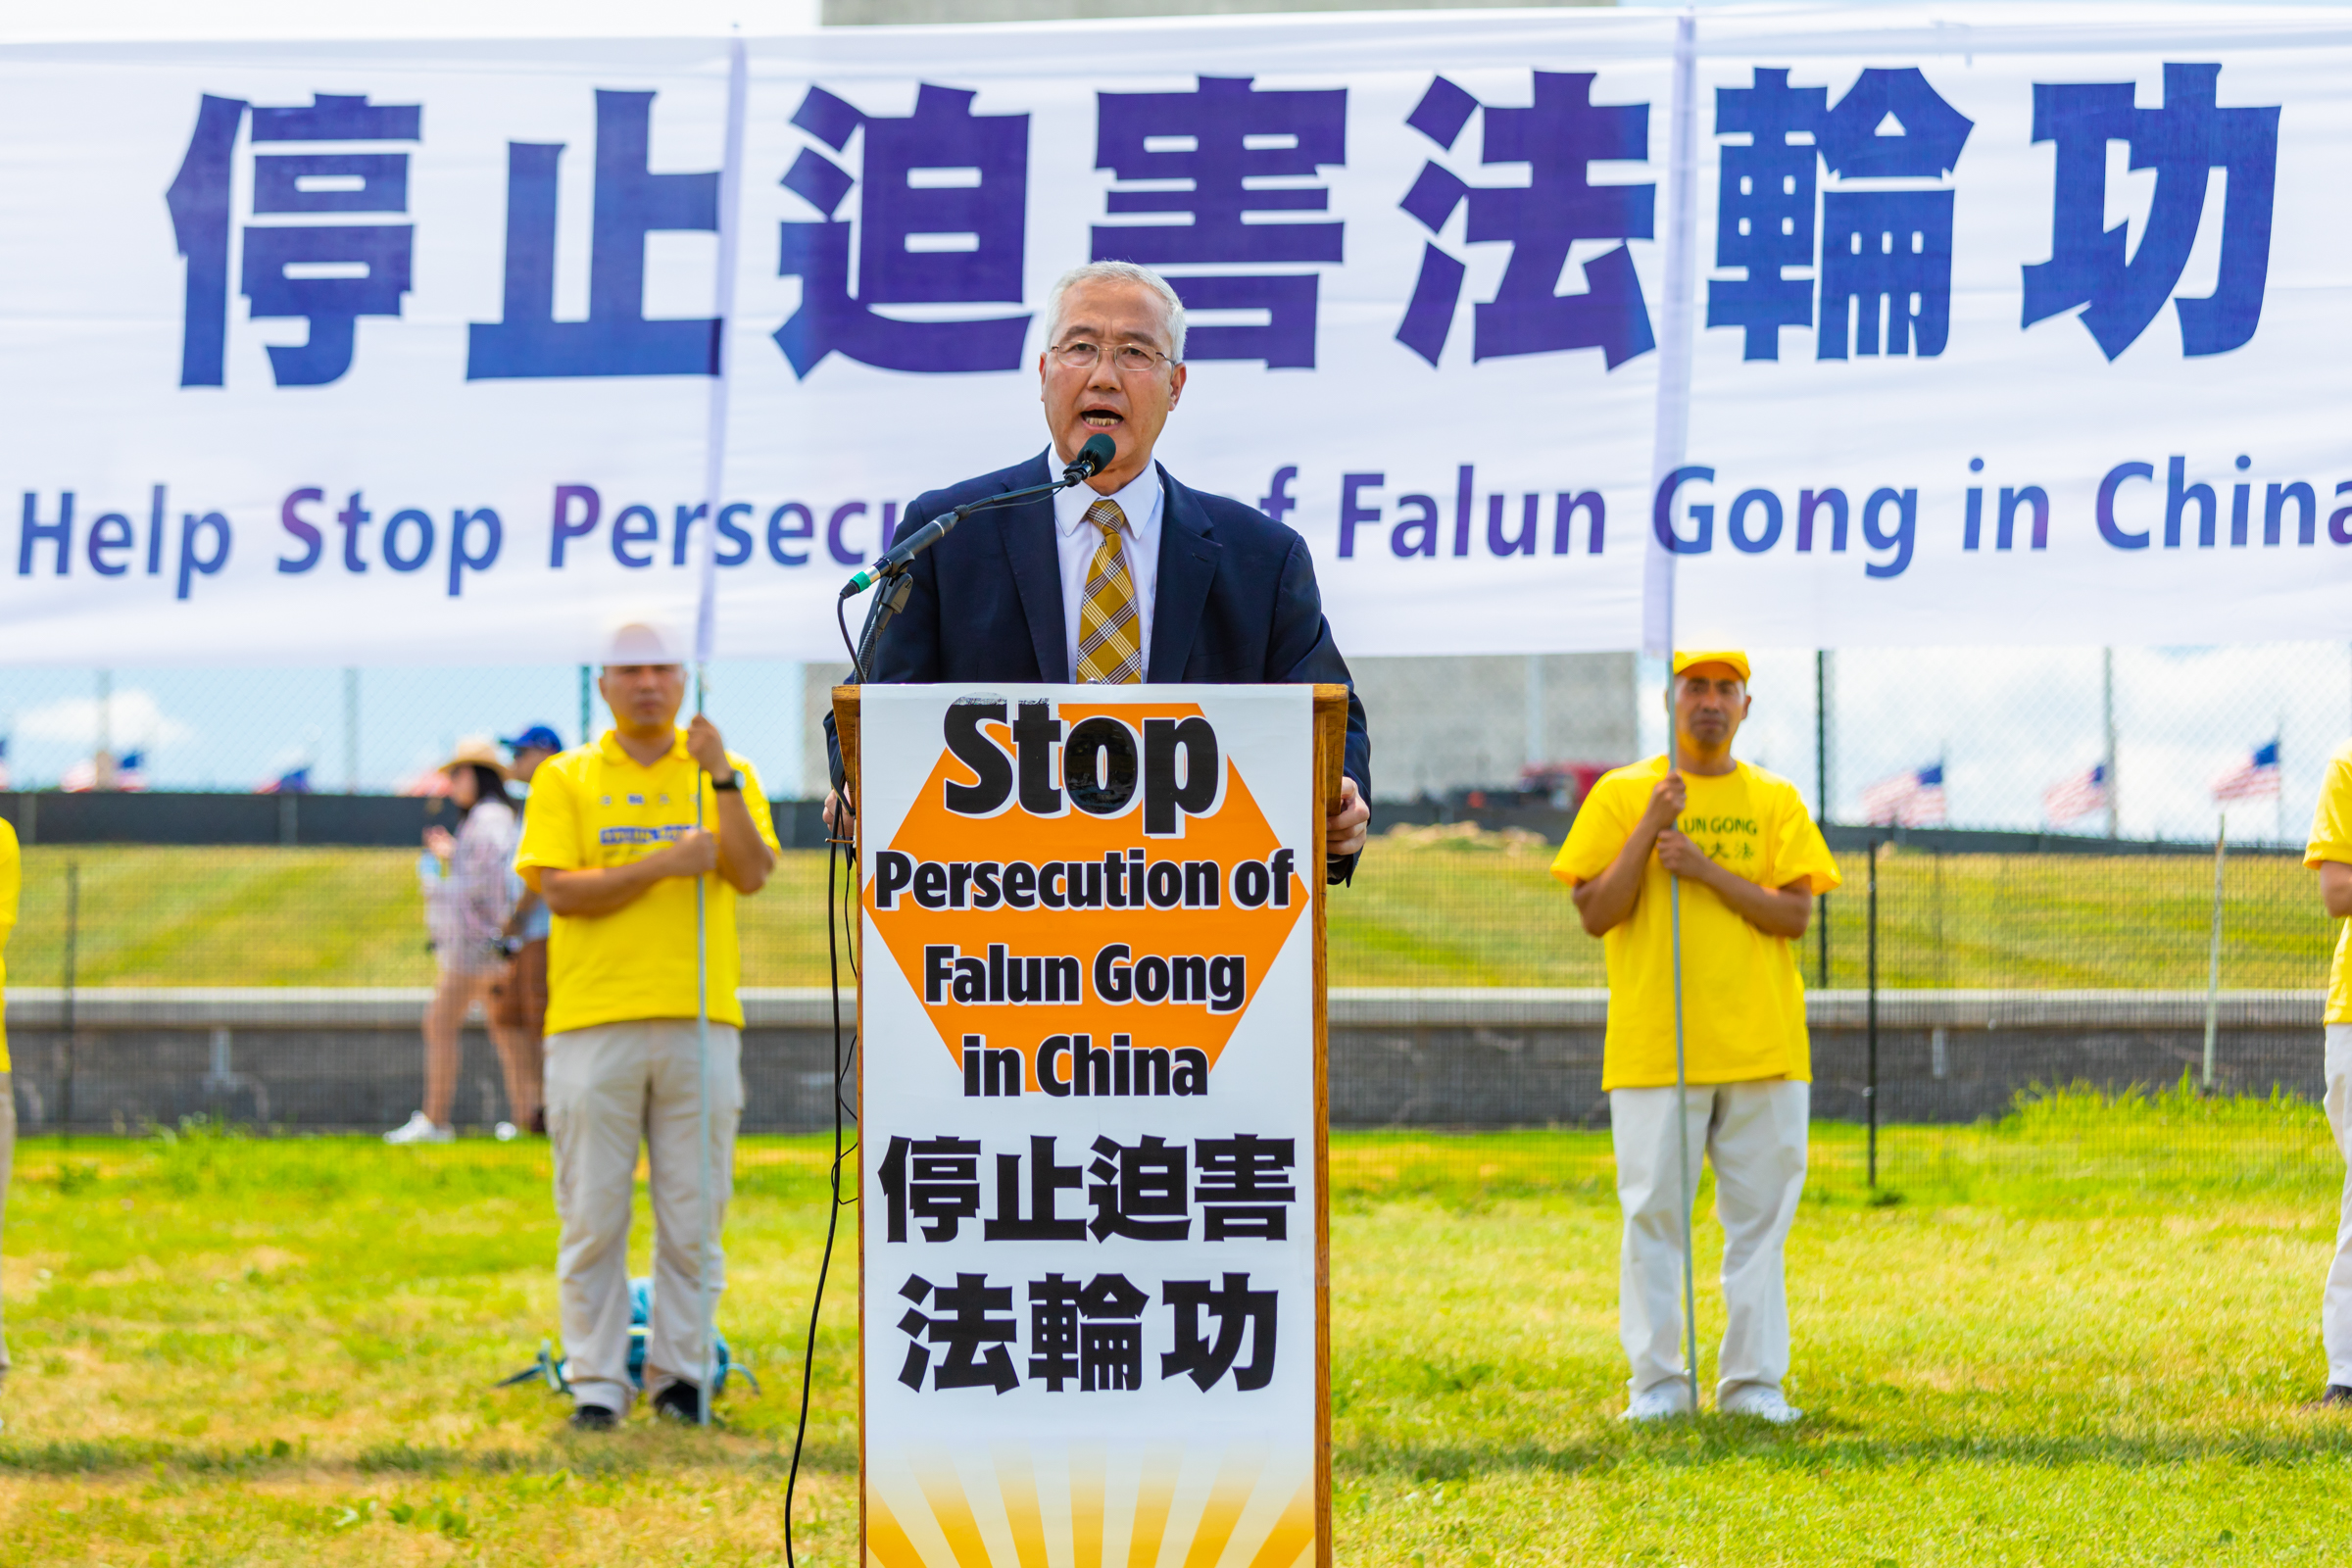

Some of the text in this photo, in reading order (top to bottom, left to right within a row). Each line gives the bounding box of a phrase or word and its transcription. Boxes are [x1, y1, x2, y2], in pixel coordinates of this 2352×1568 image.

[164, 61, 2283, 390] 停止迫害法輪功
[17, 484, 233, 602] Help
[276, 486, 504, 598] Stop
[1337, 464, 1606, 560] Falun
[1651, 465, 1918, 580] Gong
[1962, 457, 2050, 552] in
[943, 693, 1220, 835] Stop
[875, 849, 1295, 909] Persecution of
[1710, 816, 1757, 836] GONG
[924, 944, 1246, 1011] Falun Gong
[963, 1035, 1207, 1097] in China
[877, 1133, 1296, 1244] 停止迫害
[897, 1272, 1279, 1396] 法輪功
